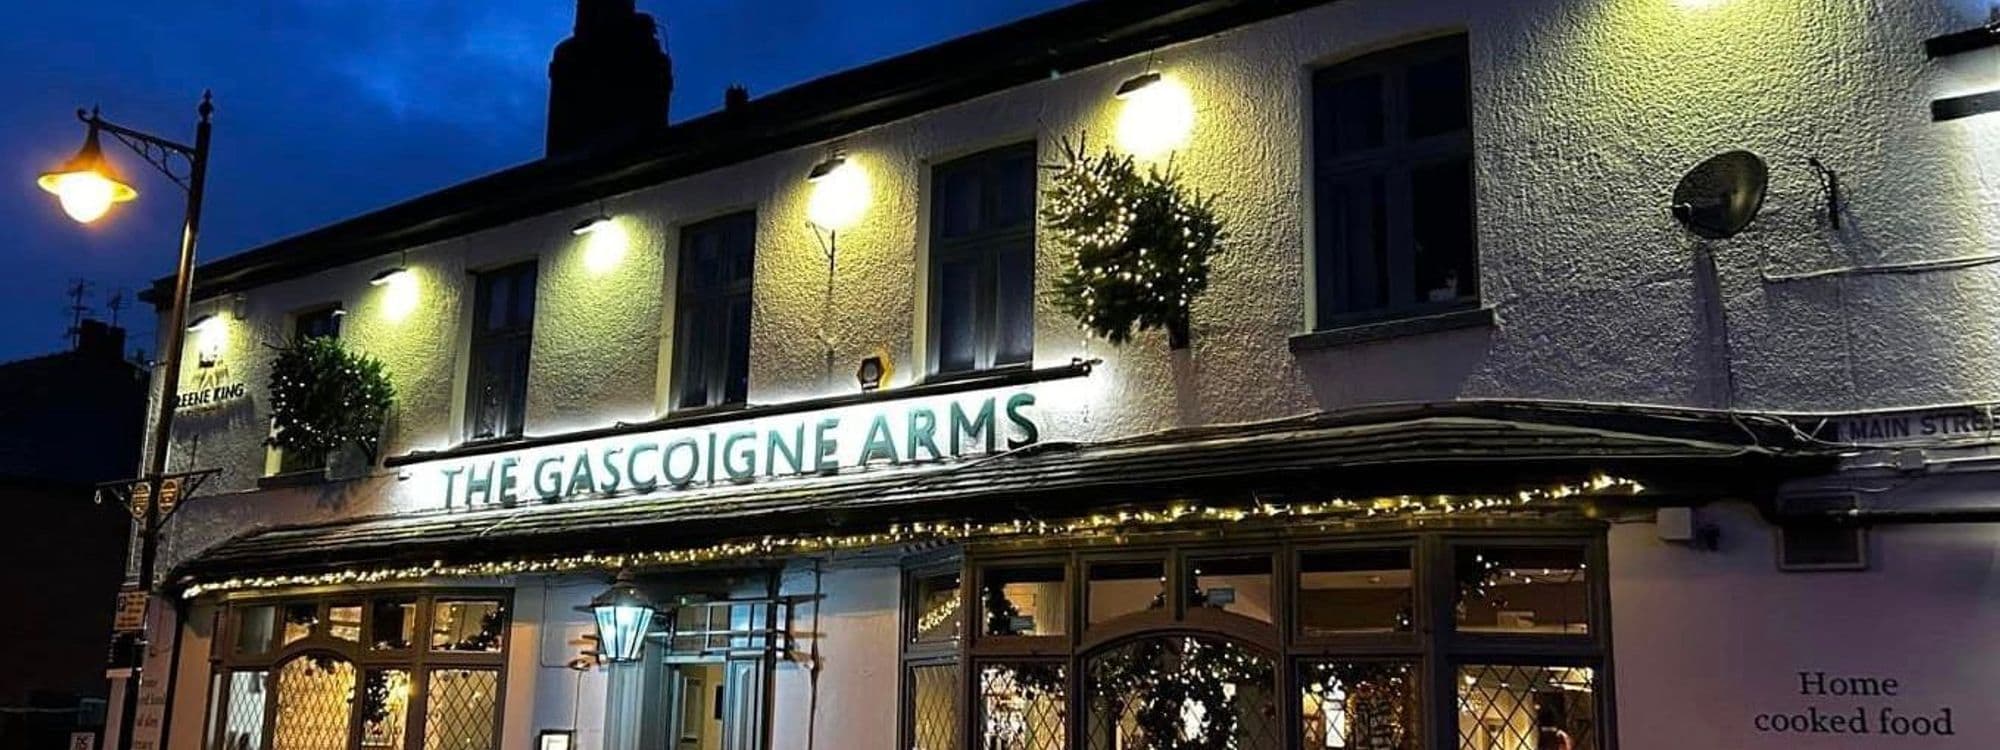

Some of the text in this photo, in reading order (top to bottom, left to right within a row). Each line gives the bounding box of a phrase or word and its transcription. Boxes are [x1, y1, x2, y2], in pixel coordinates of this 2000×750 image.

[177, 383, 244, 407] REENE KING
[1849, 416, 1909, 439] MAIN
[441, 393, 1039, 510] THE GASCOIGNE ARMS
[1799, 671, 1899, 696] Home
[1754, 707, 1955, 736] cooked food
